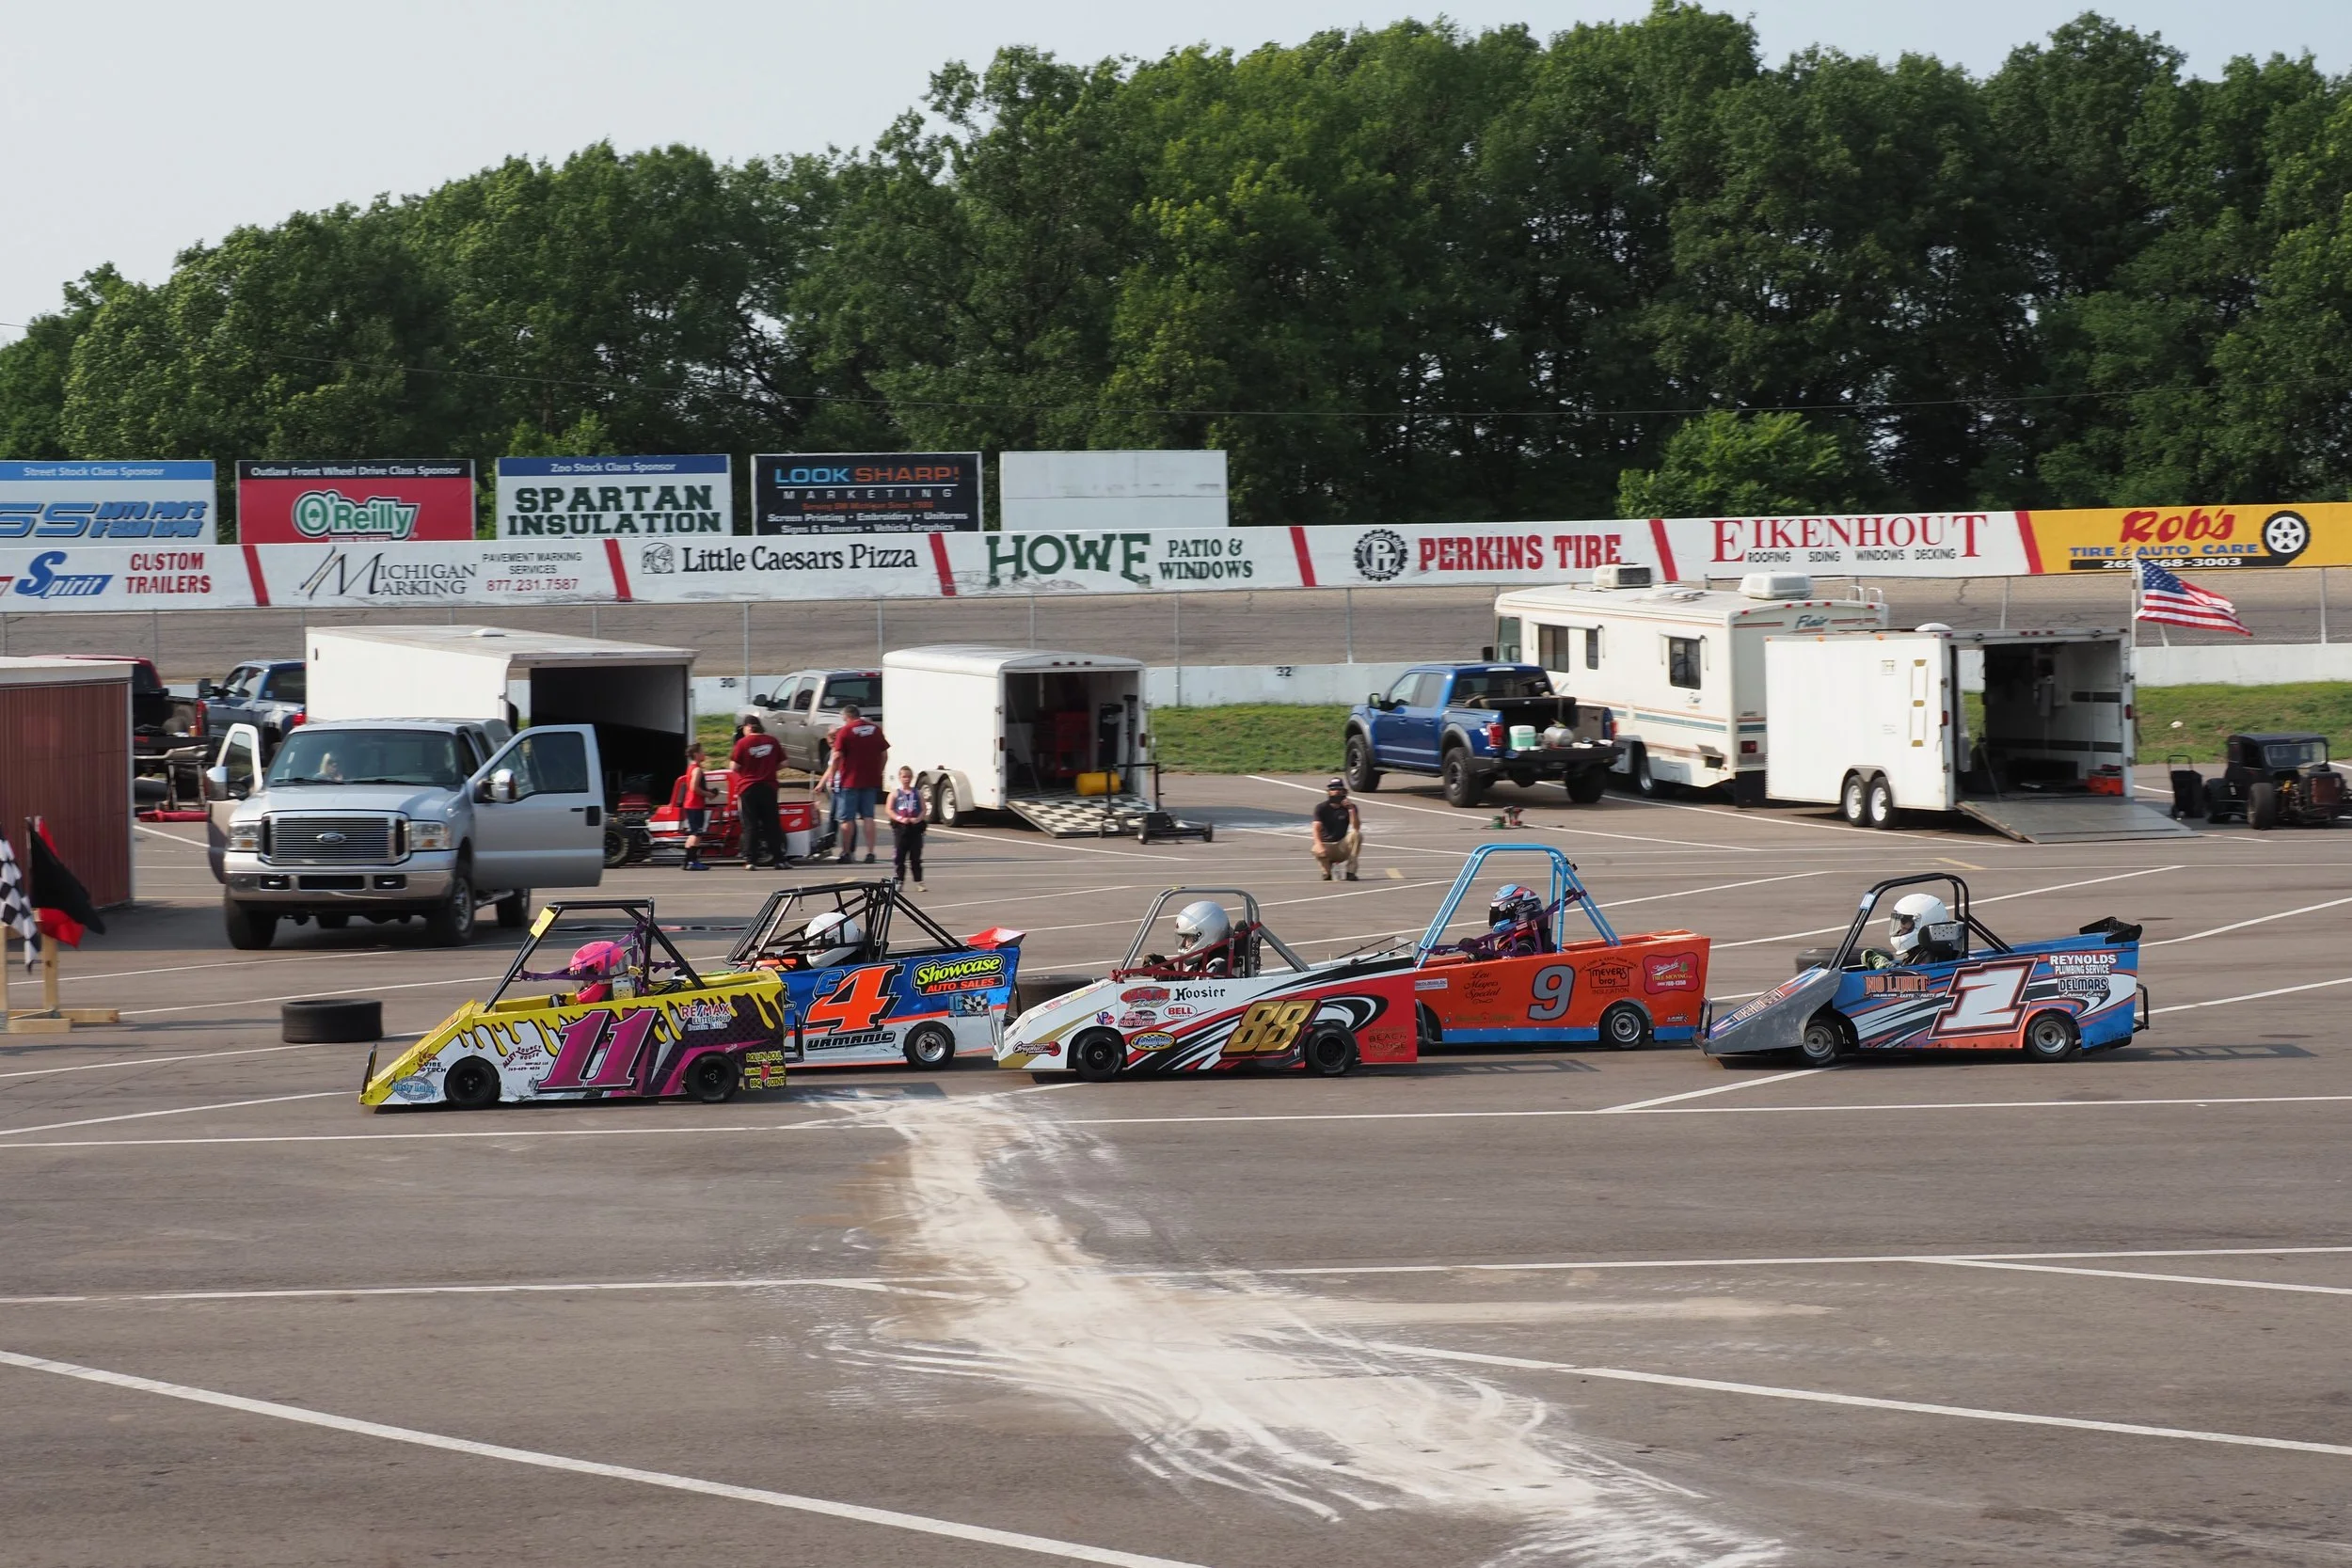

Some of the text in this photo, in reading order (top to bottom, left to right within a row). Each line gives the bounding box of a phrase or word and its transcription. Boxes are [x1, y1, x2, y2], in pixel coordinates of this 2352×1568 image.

[24, 467, 165, 478] Street Stock Class Sponsor
[250, 466, 461, 477] Outlaw Front Wheel Drive Class Sponsor
[550, 462, 676, 472] Zoo Stock Class Sponsor
[774, 467, 960, 483] LOOK SHARP!
[516, 484, 712, 513] SPARTAN
[783, 489, 952, 499] MARKETING
[299, 495, 415, 535] O'Reilly
[767, 512, 968, 523] Screen Printing Embroidery Uniforms
[507, 513, 722, 535] INSULATION
[781, 524, 810, 534] Signs
[822, 524, 863, 532] Banners
[874, 523, 910, 532] Vehicle
[911, 522, 956, 533] Graphics
[2119, 508, 2235, 544] Rob's
[1709, 515, 1989, 562] EIKENHOUT
[1168, 538, 1244, 558] PATIO &
[1418, 534, 1543, 571] PERKINS
[1553, 534, 1622, 569] TIRE
[1747, 548, 1957, 562] ROOFING SIDING WINDOWS DECKING
[2070, 546, 2115, 557] TIRE
[2137, 545, 2191, 556] AUTO
[2202, 544, 2258, 555] CARE
[130, 552, 205, 571] CUSTOM
[483, 552, 582, 562] PAVEMENT MARKING
[681, 544, 918, 572] Little Caesars Pizza
[986, 533, 1152, 589] HOWE
[15, 551, 114, 599] Spirit
[509, 565, 557, 575] SERVICES
[1158, 561, 1254, 580] WINDOWS
[125, 575, 212, 594] TRAILERS
[486, 578, 580, 592] 877.231.7587
[1276, 666, 1293, 677] 32
[2049, 954, 2117, 965] REYNOLDS
[915, 957, 1001, 985] Showcase
[1592, 967, 1628, 979] MEYERS
[2055, 964, 2109, 974] PLUMBING SERVICE
[926, 977, 995, 993] AUTO SALES
[1865, 975, 1929, 994] NO LIMIT
[2059, 978, 2108, 990] DELMARS
[804, 964, 898, 1034] 4
[1173, 987, 1226, 1001] Hoosier
[1526, 964, 1577, 1022] 9
[1938, 964, 2034, 1032] 1
[682, 1005, 730, 1018] RE/MAX
[1224, 1000, 1321, 1053] 88
[1369, 1033, 1407, 1043] BEACH
[536, 1007, 659, 1091] 11
[1369, 1043, 1407, 1053] HOUSE
